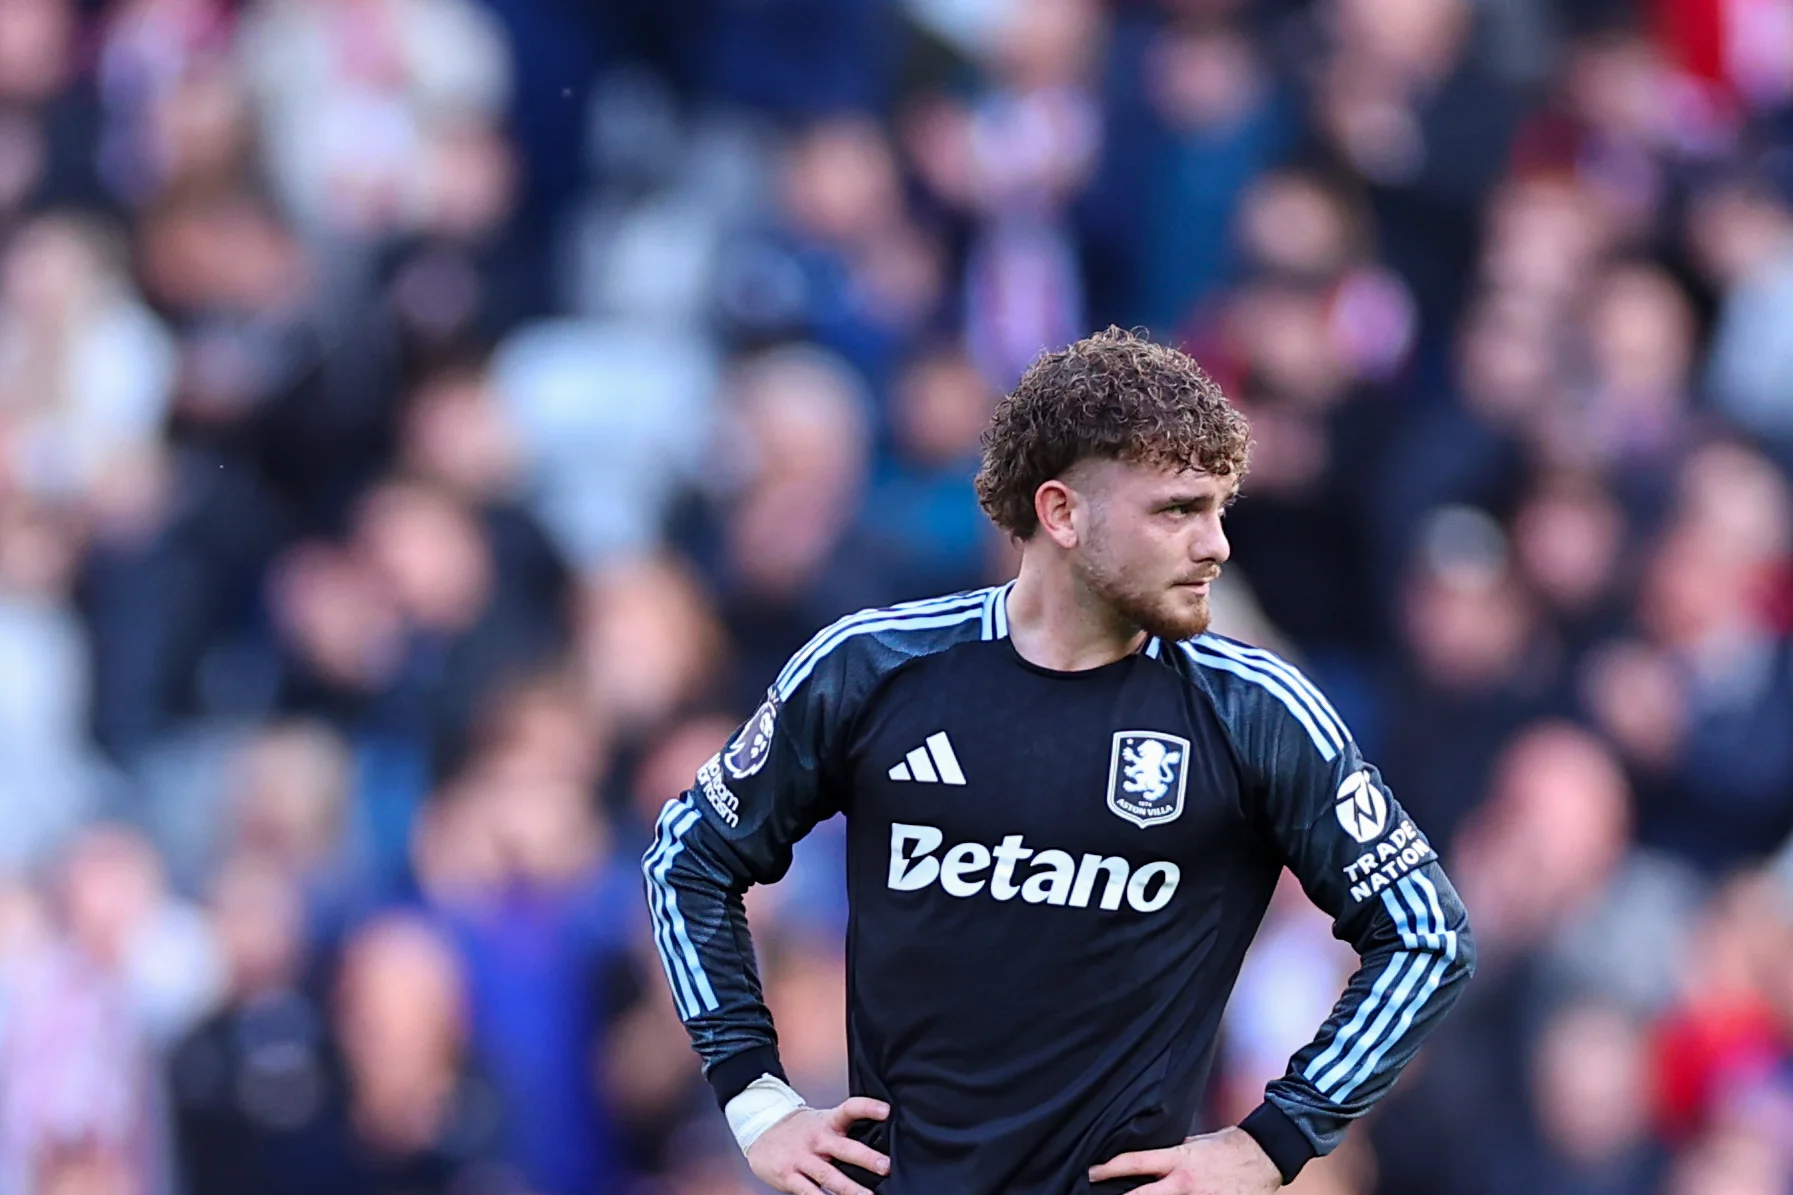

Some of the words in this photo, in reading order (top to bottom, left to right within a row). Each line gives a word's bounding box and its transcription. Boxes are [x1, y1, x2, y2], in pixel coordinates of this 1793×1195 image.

[1116, 799, 1146, 815] ASTON
[1147, 805, 1173, 816] VILLA
[887, 822, 1181, 913] Betano
[1343, 819, 1417, 882] TRADE
[1350, 838, 1430, 903] NATION
